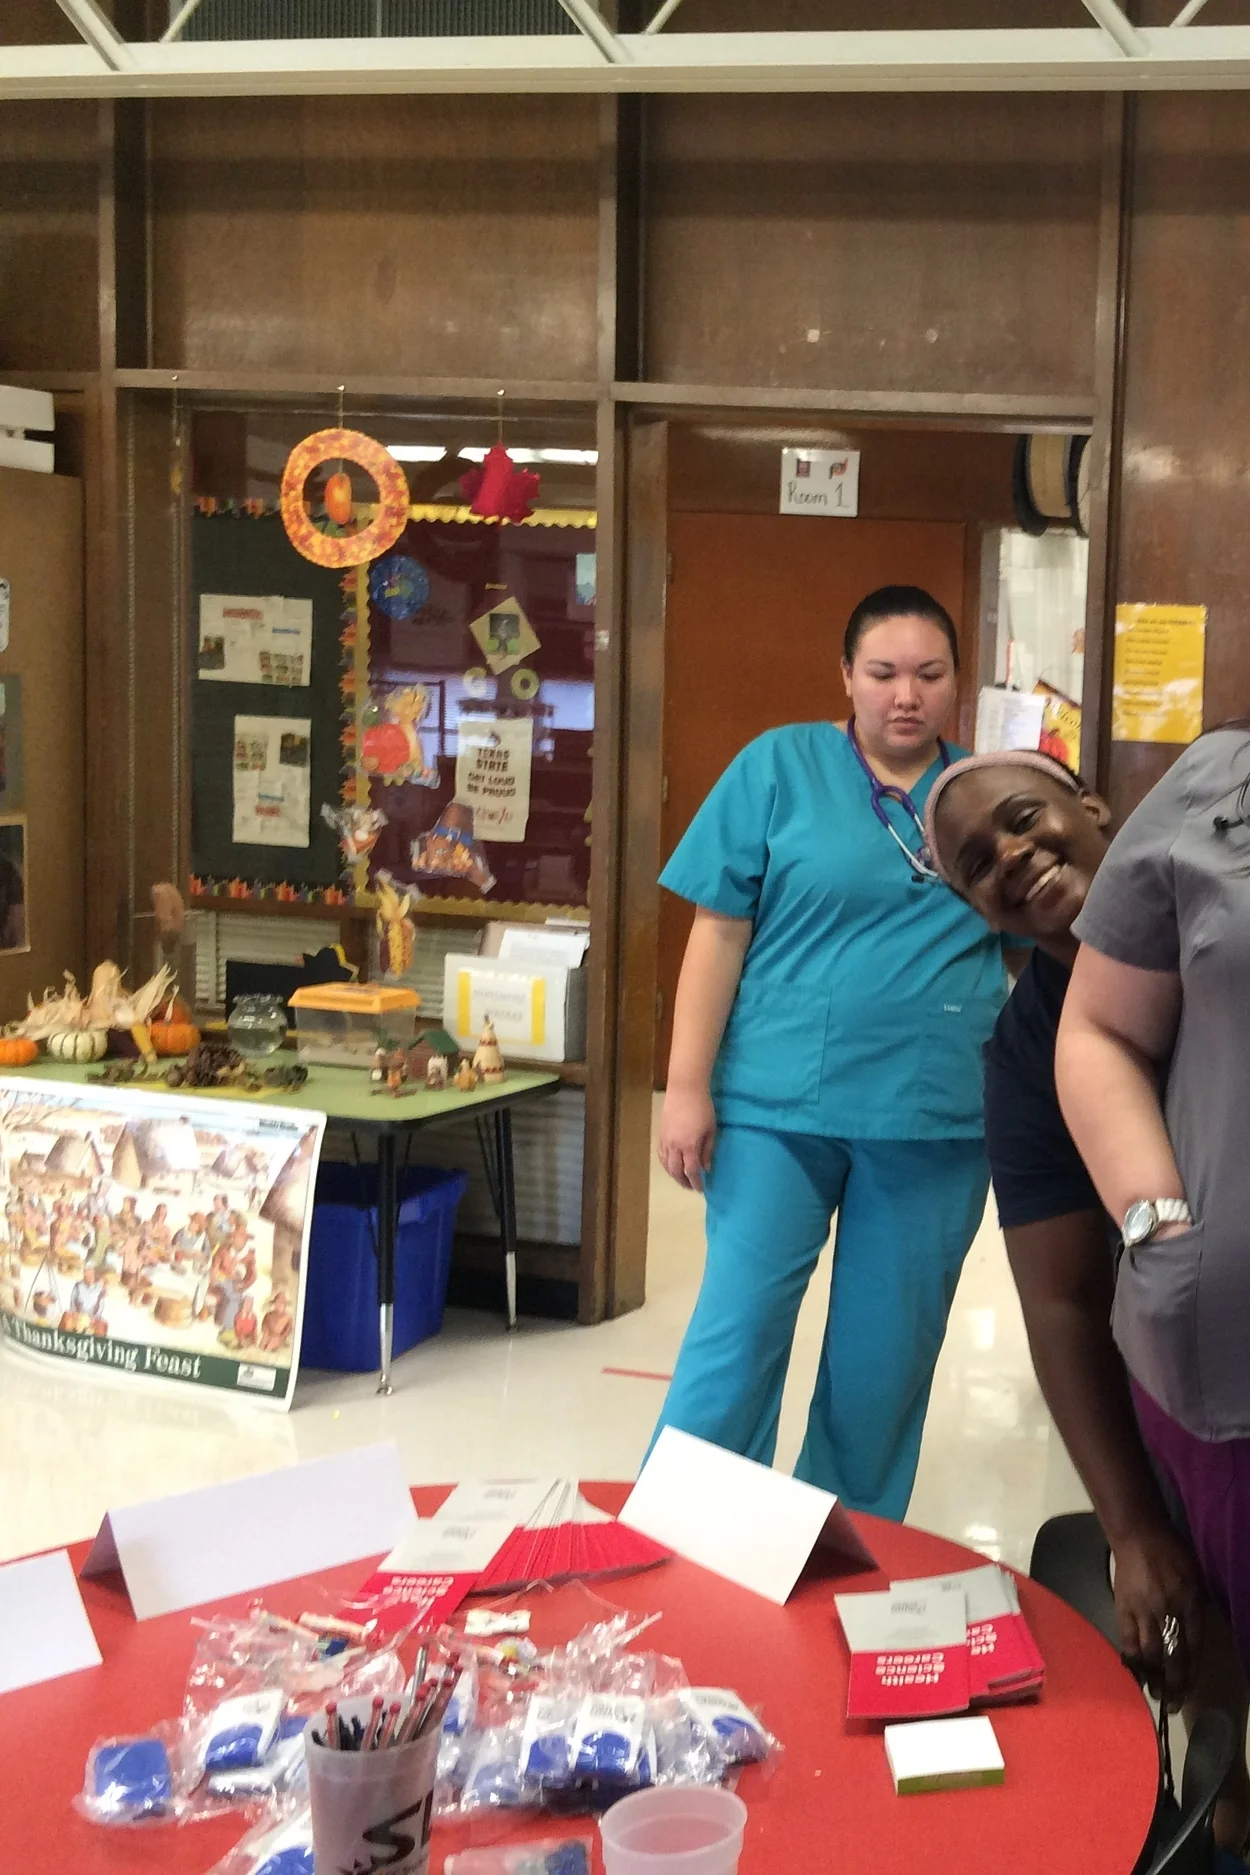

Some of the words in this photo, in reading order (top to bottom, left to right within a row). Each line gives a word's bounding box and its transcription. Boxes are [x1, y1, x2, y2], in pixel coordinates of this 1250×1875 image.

[833, 482, 851, 508] 1
[12, 1315, 138, 1372] Thanksgiving
[144, 1345, 201, 1379] Feast
[877, 1652, 944, 1665] Careers
[881, 1673, 939, 1686] Health
